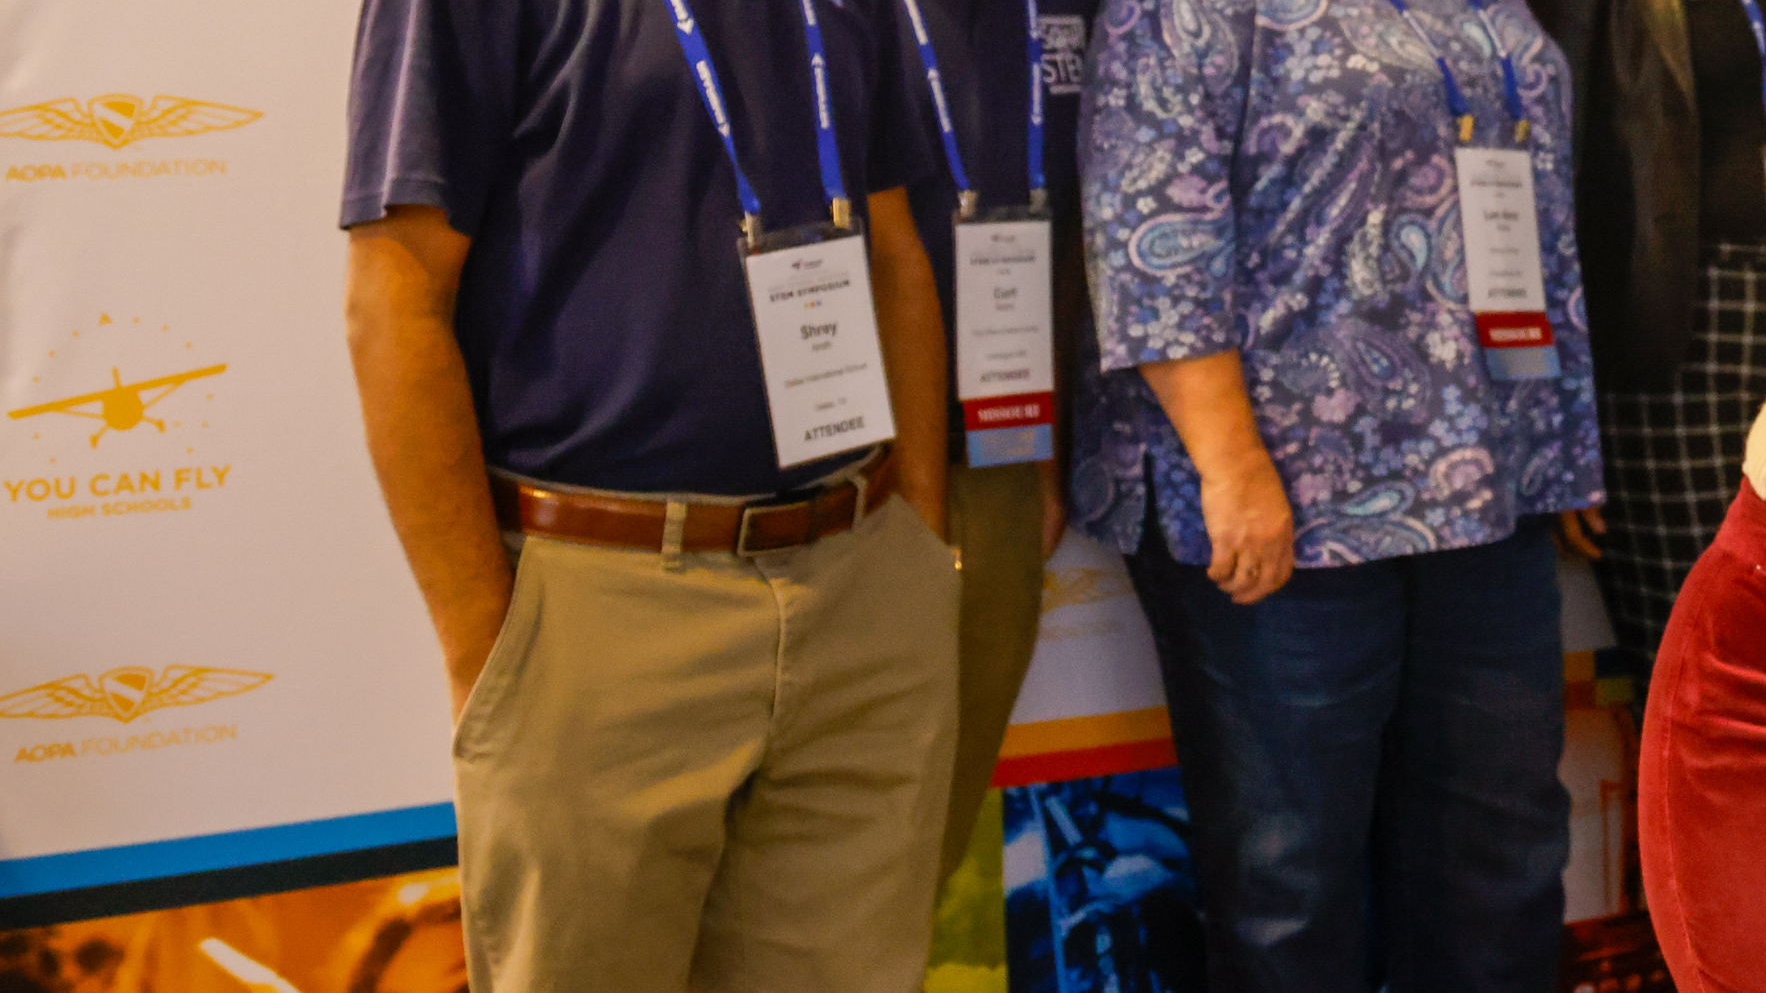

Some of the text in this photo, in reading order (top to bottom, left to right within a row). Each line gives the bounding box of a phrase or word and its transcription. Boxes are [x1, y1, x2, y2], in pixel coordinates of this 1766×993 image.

[5, 159, 228, 182] AOPA FOUNDATION
[800, 321, 838, 341] Shrey
[804, 415, 865, 442] ATTENDEE
[4, 464, 232, 503] YOU CAN FLY
[47, 496, 192, 520] HIGH SCHOOLS
[14, 724, 238, 764] AOPA FOUNDATION
